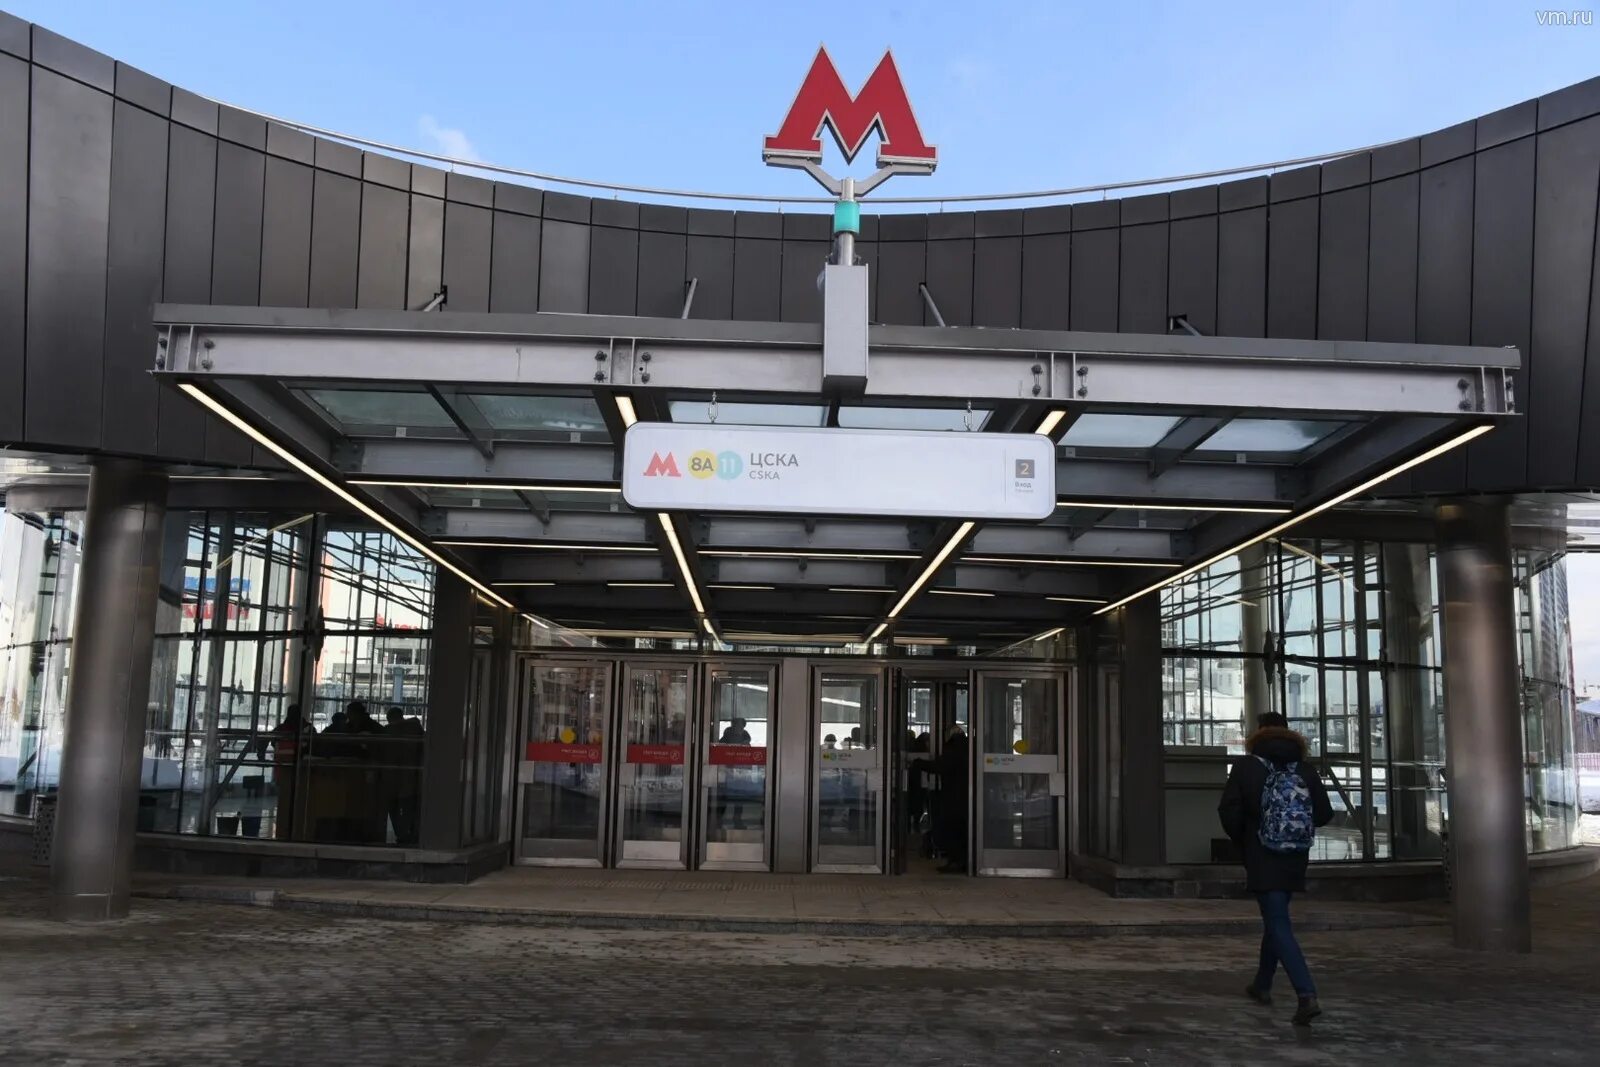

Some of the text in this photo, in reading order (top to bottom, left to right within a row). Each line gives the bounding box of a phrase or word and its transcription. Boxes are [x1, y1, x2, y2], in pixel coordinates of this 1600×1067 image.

[762, 43, 938, 165] М
[643, 451, 682, 477] М
[719, 457, 737, 474] 11
[750, 452, 799, 468] ЦСКА
[1020, 462, 1030, 475] 2
[749, 470, 781, 480] CSKA
